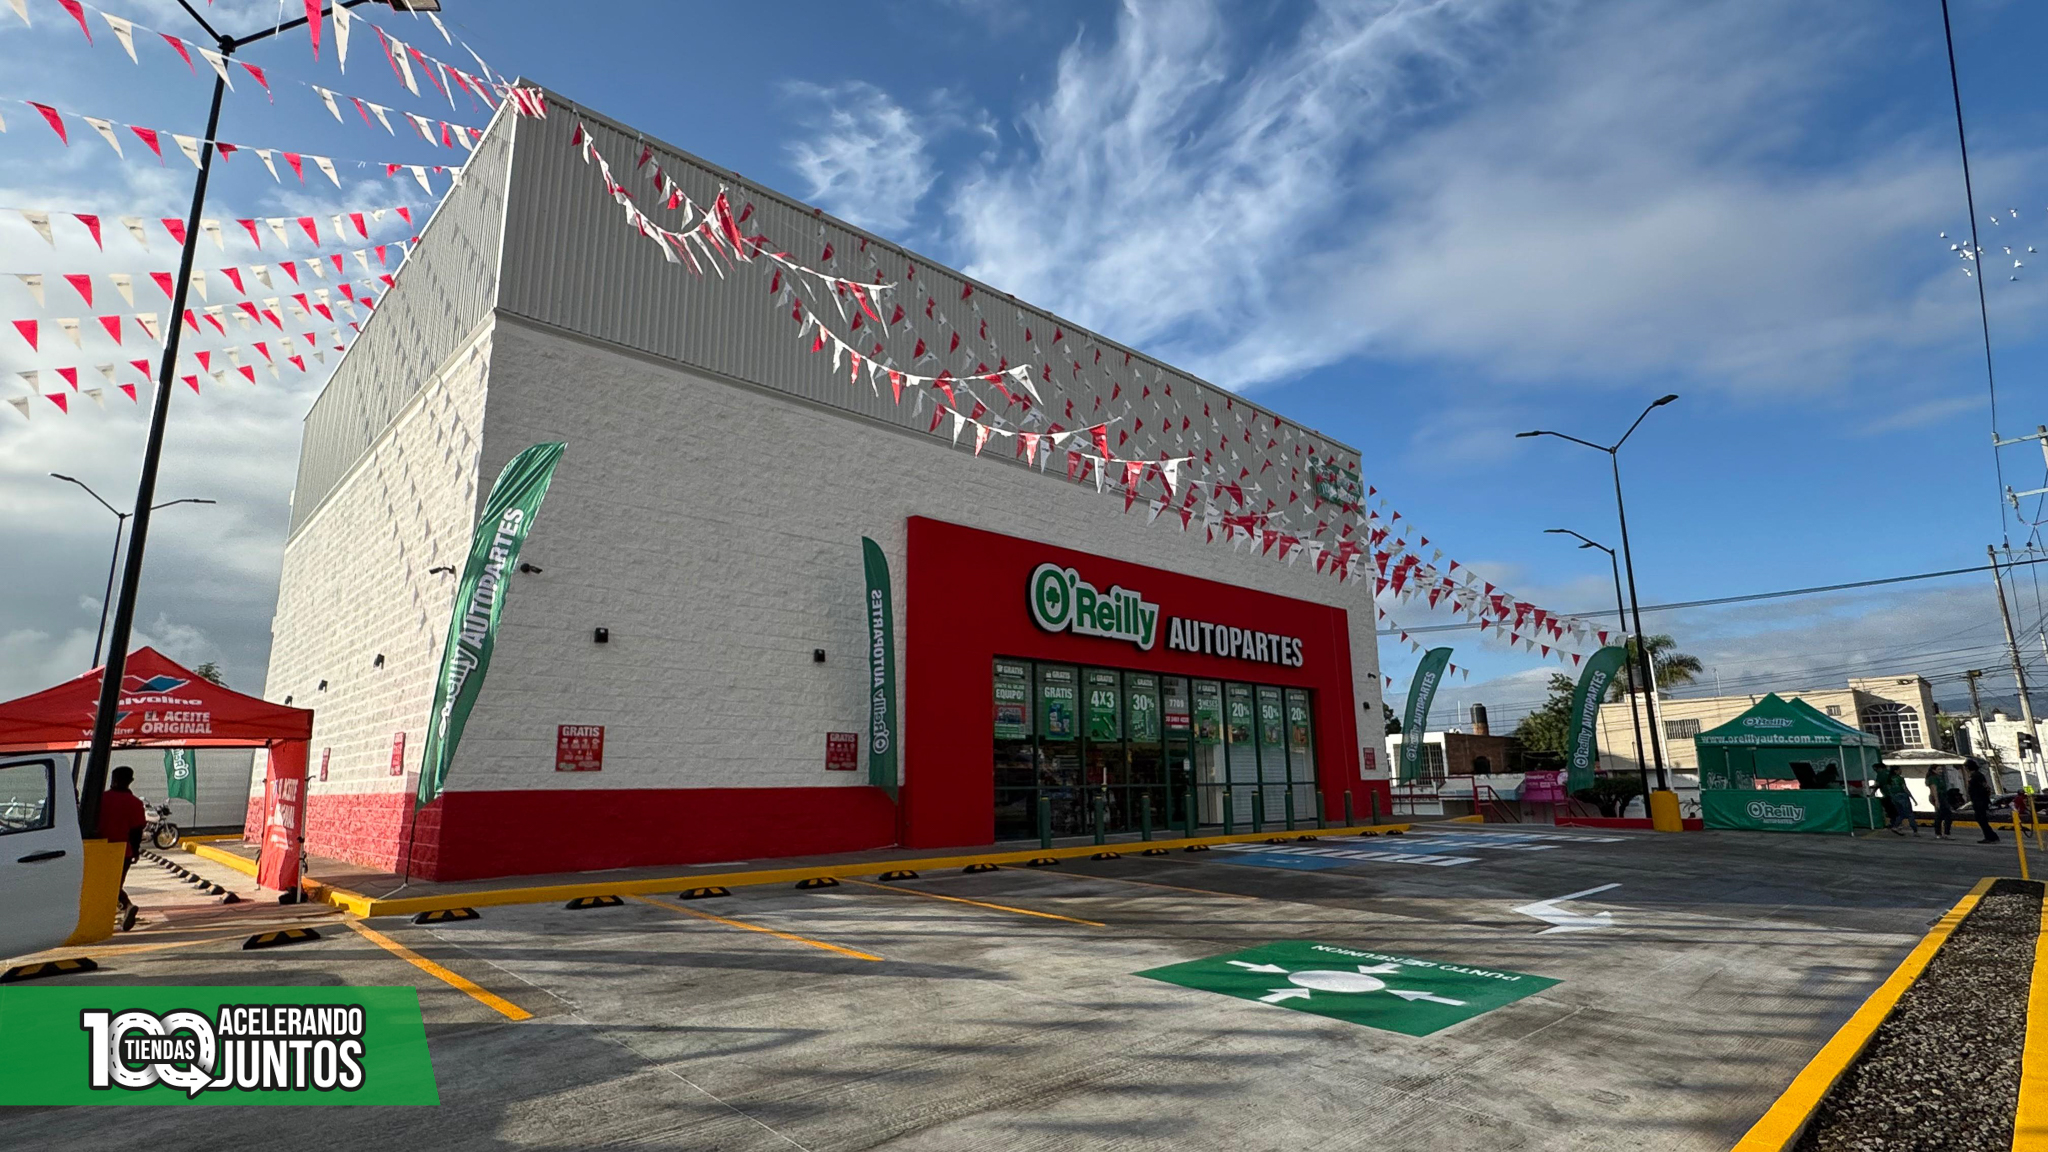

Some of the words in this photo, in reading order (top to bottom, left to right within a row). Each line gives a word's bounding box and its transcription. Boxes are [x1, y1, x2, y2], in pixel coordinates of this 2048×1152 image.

[460, 508, 525, 650] AUTOPARTES
[1031, 563, 1159, 650] O'Reilly
[1169, 616, 1303, 668] AUTOPARTES
[1044, 687, 1072, 699] GRATIS
[1413, 671, 1436, 726] AUTOPARTES
[1581, 670, 1607, 729] AUTOPARTES
[92, 696, 202, 706] lvoline
[1132, 693, 1154, 711] 30%
[144, 711, 160, 722] EL
[163, 711, 210, 722] ACEITE
[1232, 702, 1250, 718] 20%
[1262, 704, 1279, 719] 50%
[1291, 707, 1306, 721] 20%
[82, 728, 135, 736] Valine
[141, 722, 212, 734] ORIGINAL
[562, 726, 600, 737] GRATIS
[829, 733, 856, 742] GRATIS
[1701, 733, 1832, 745] www.oreillyauto.com.mx
[1573, 727, 1593, 768] O'Reilly
[1746, 800, 1803, 821] O'Reilly
[1311, 945, 1403, 963] REUNION
[1439, 964, 1521, 981] PUNTO
